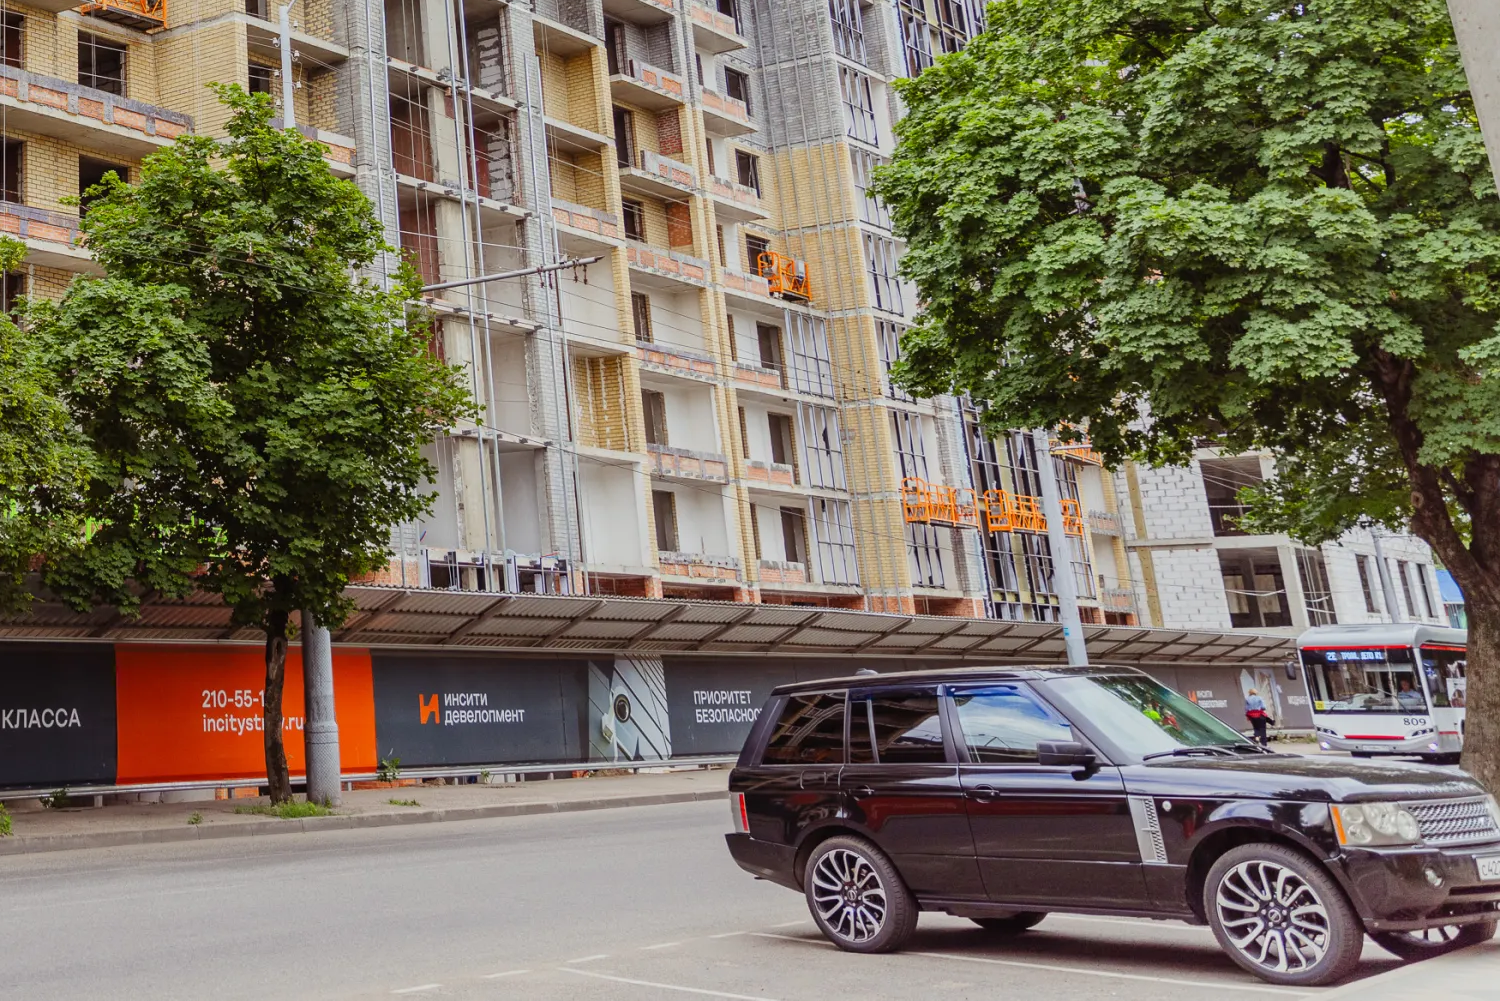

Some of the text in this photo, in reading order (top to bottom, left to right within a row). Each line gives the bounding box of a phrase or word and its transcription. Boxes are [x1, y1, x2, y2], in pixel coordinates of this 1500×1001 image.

[444, 693, 488, 707] ИНСИТИ
[693, 690, 752, 705] ПРИОРИТЕТ
[203, 714, 304, 736] incitystr.ru
[444, 709, 525, 726] девелопмент
[1403, 717, 1427, 726] 809
